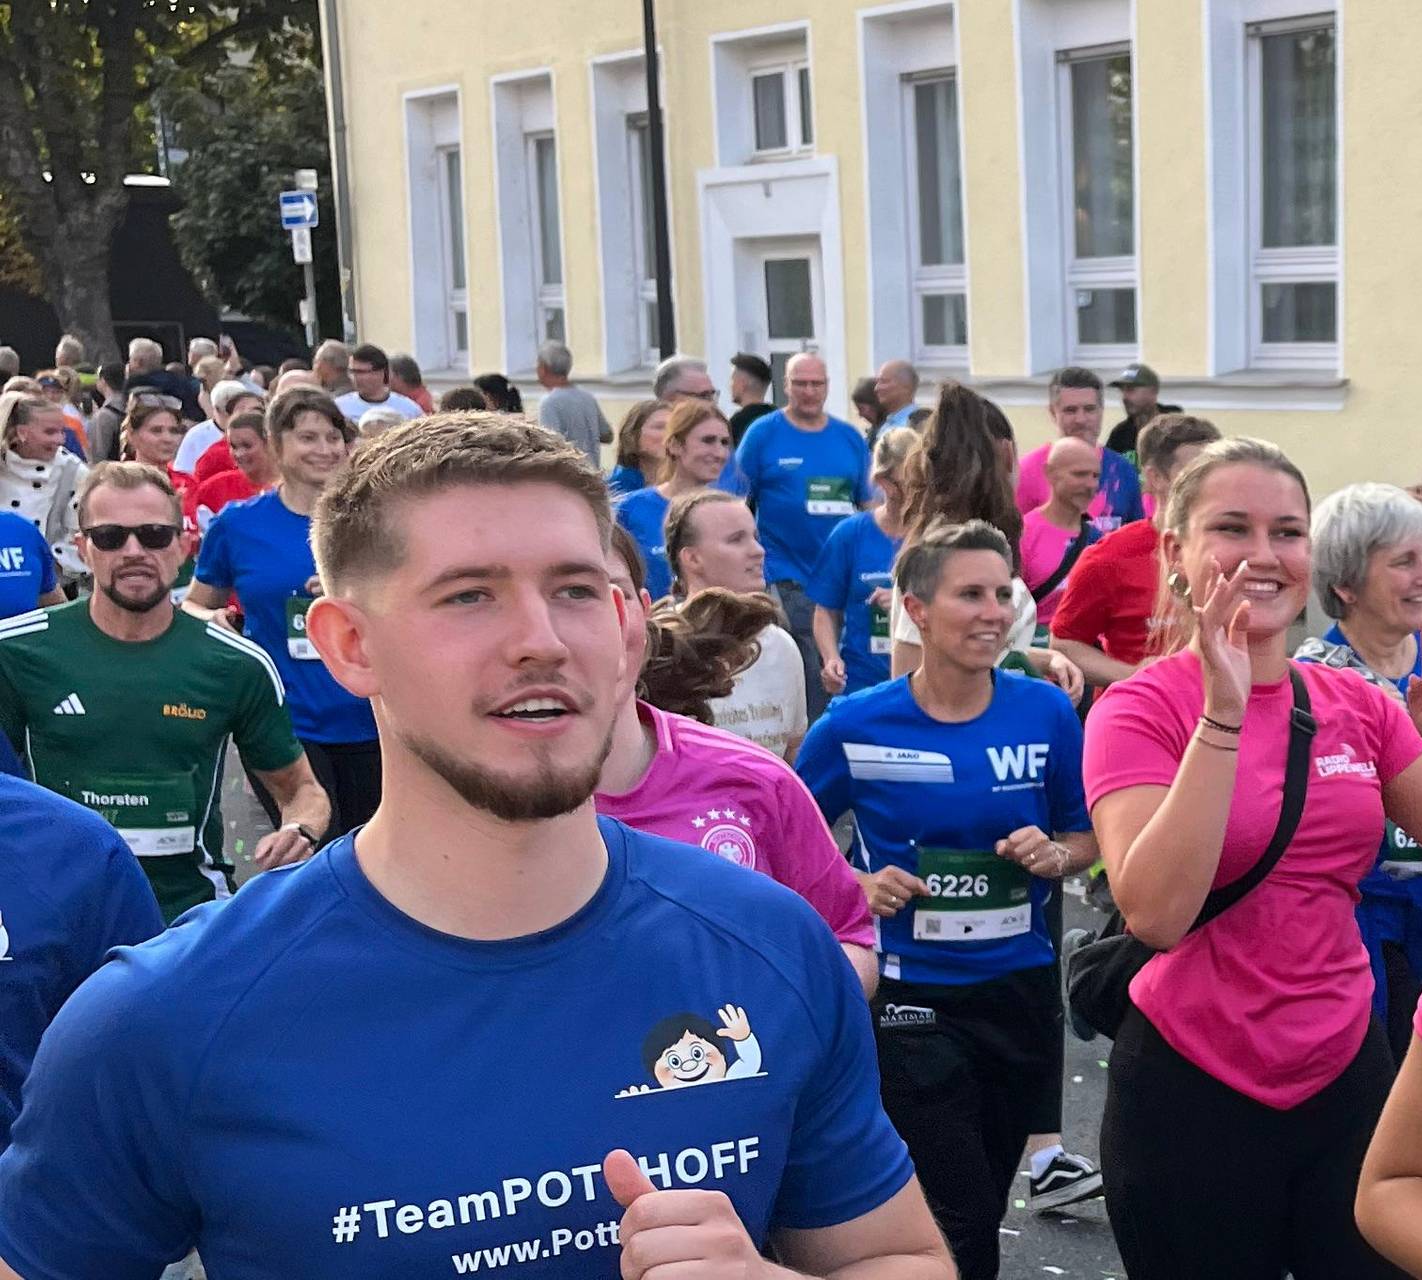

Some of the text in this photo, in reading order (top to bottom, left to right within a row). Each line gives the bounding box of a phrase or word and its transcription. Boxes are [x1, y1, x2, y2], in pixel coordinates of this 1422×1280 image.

[986, 743, 1049, 781] WF
[81, 791, 149, 806] Thorsten
[926, 874, 989, 898] 6226
[332, 1136, 760, 1244] #TeamPOTHOFF
[451, 1223, 622, 1275] www.Pott
